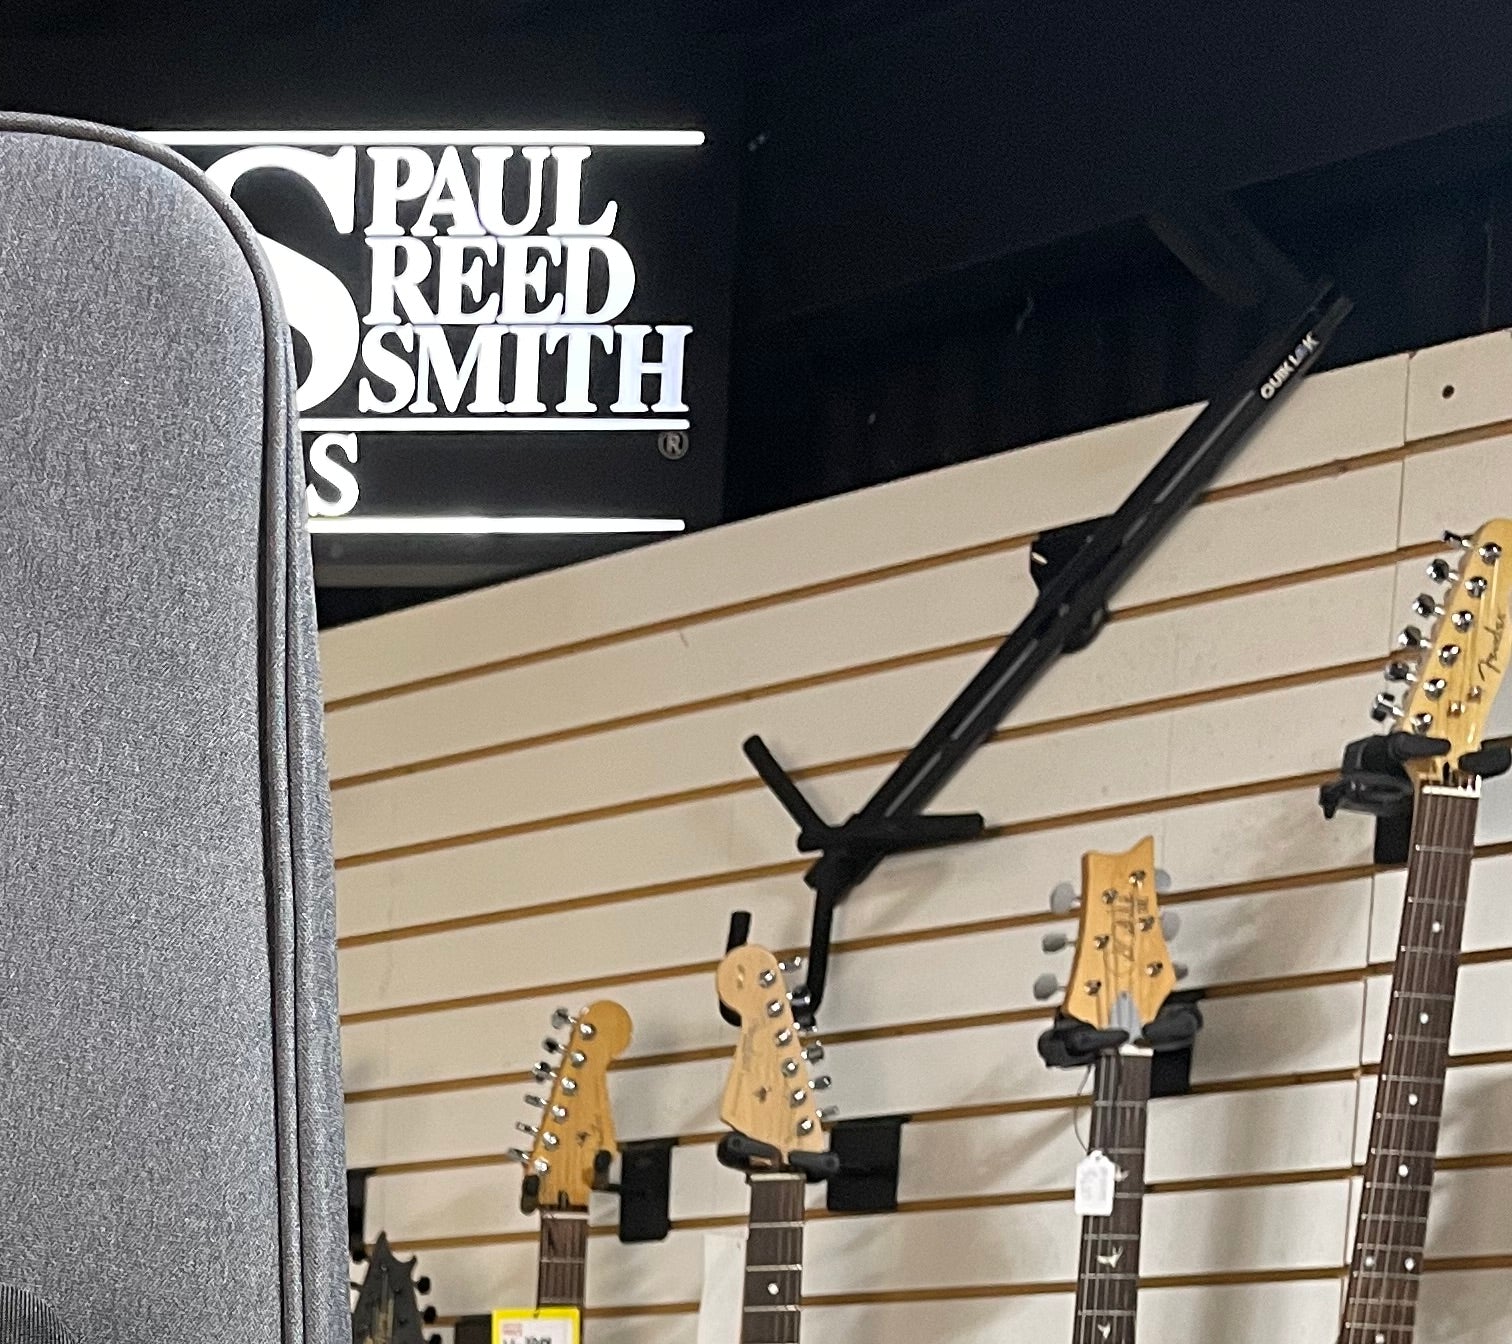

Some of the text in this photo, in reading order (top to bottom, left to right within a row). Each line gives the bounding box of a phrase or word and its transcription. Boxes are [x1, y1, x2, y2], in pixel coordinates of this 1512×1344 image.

[364, 145, 619, 237] PAUL
[362, 235, 637, 325] REED
[358, 323, 693, 413] SMITH
